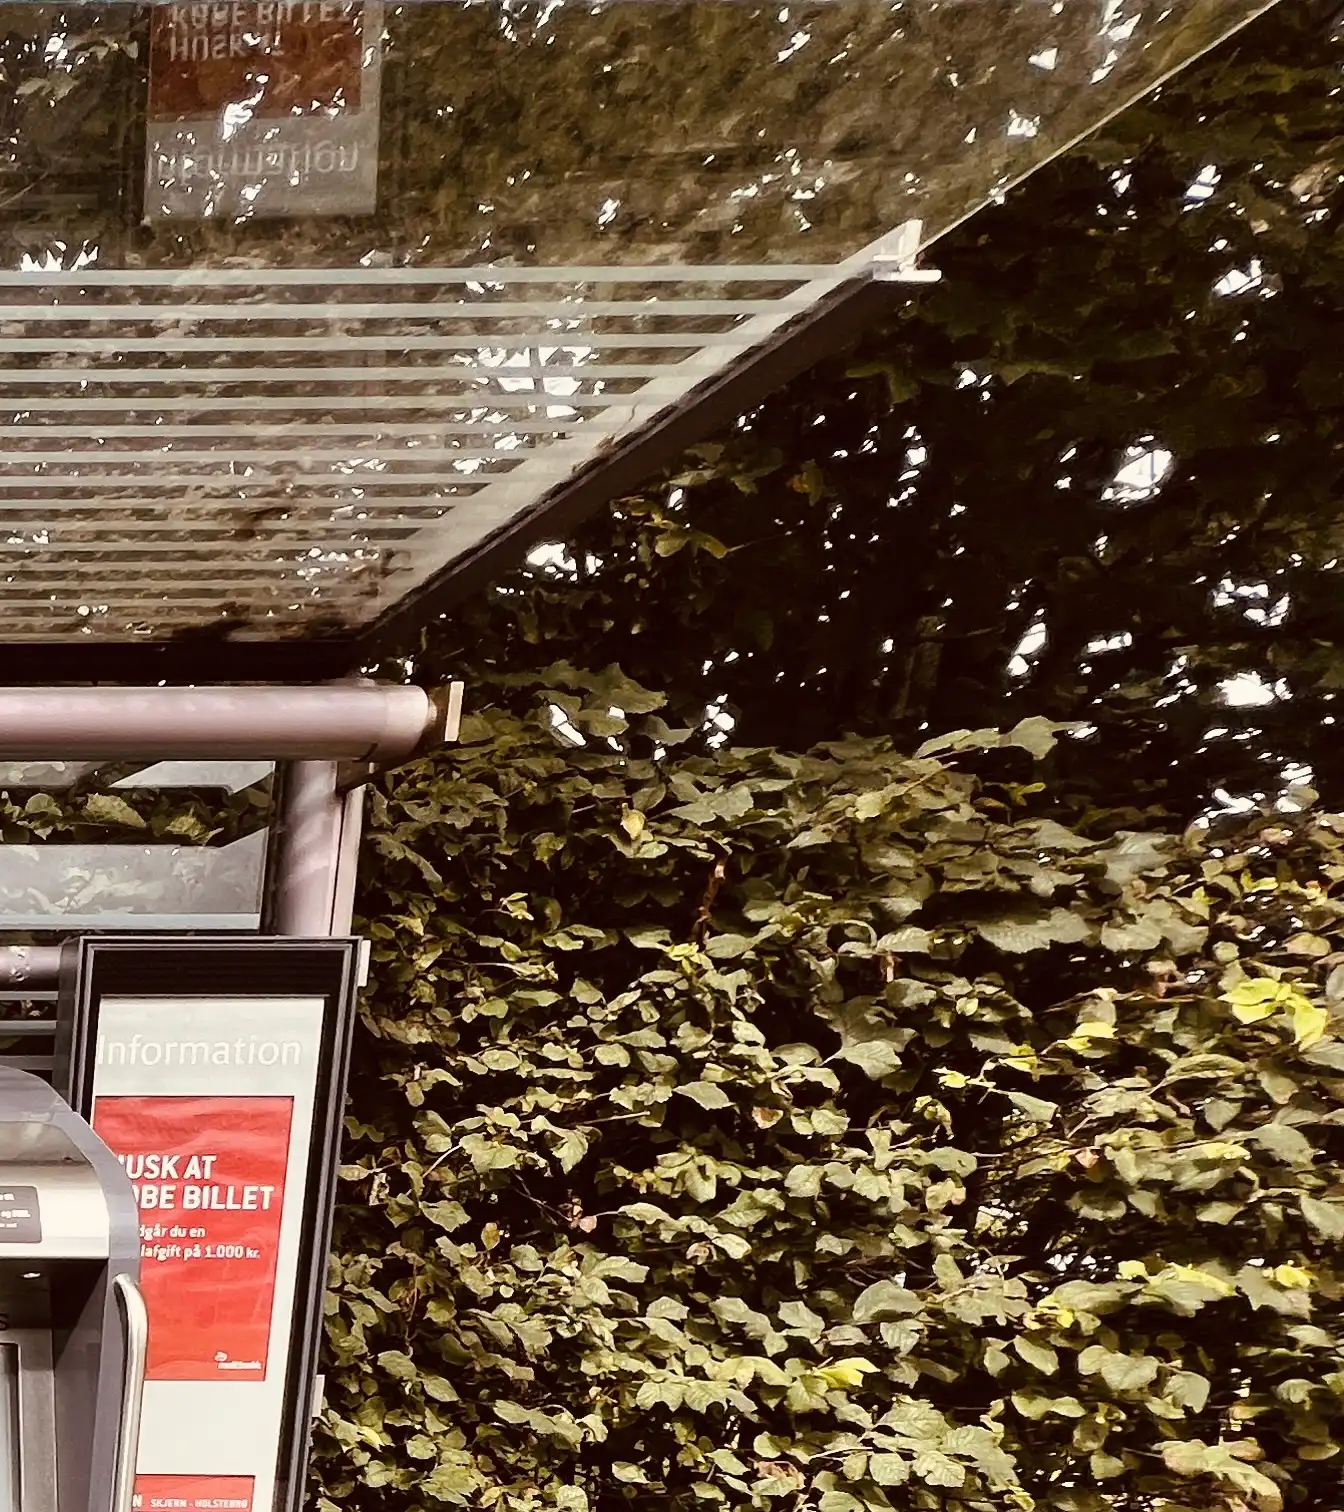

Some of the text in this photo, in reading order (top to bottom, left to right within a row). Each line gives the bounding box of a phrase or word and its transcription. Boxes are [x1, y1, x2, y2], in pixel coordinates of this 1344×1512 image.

[98, 1034, 302, 1066] Information
[117, 1154, 217, 1180] USK AT
[181, 1185, 275, 1210] BILLET
[170, 1225, 187, 1238] du
[189, 1227, 206, 1238] en
[140, 1243, 261, 1261] lafgift på 1.000 kr.
[150, 1498, 187, 1508] SKJERN
[194, 1499, 249, 1509] HOLSTEBRO
